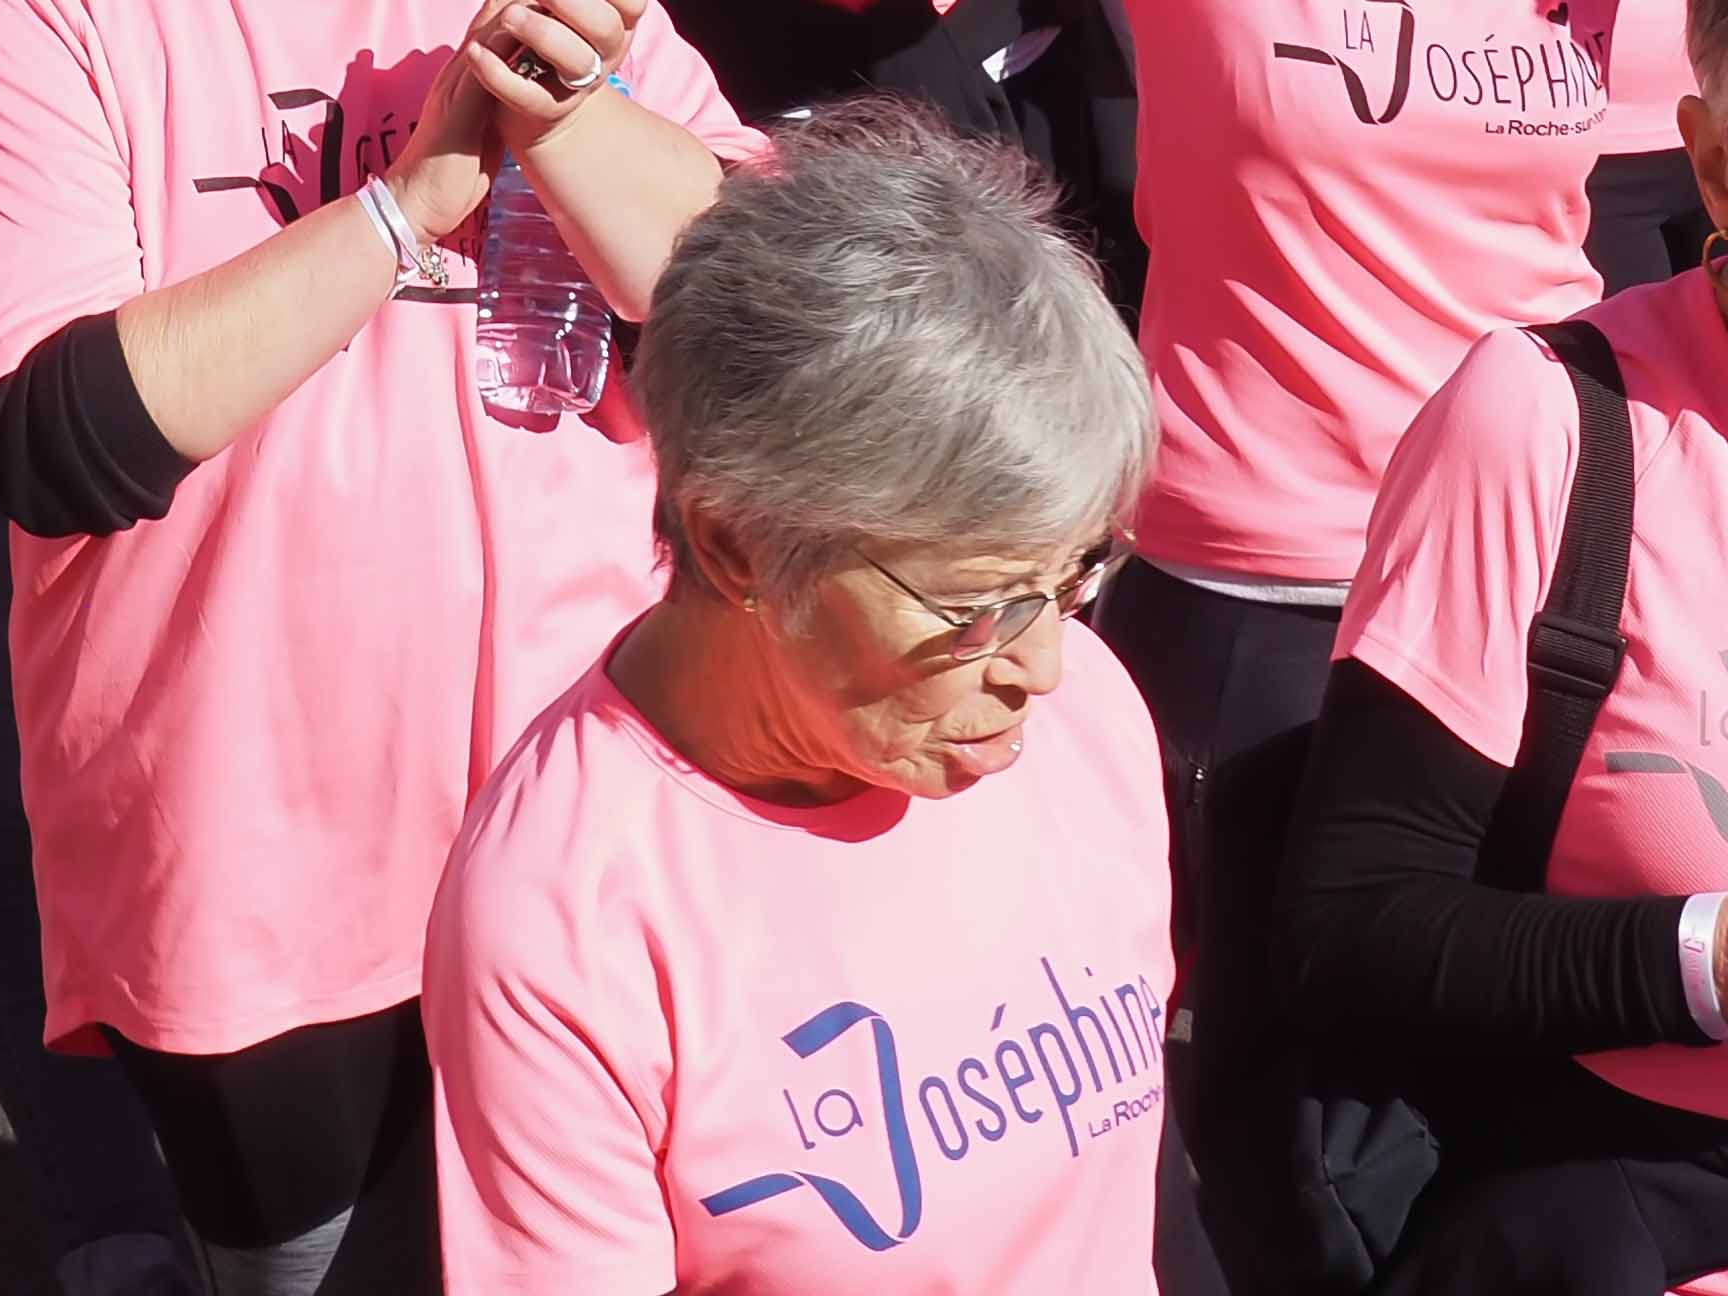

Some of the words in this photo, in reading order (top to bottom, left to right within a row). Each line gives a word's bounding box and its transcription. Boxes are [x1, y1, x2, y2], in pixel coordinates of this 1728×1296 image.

[1343, 9, 1374, 53] LA
[1486, 121, 1505, 134] La
[784, 1089, 863, 1150] la
[1088, 1116, 1113, 1138] La
